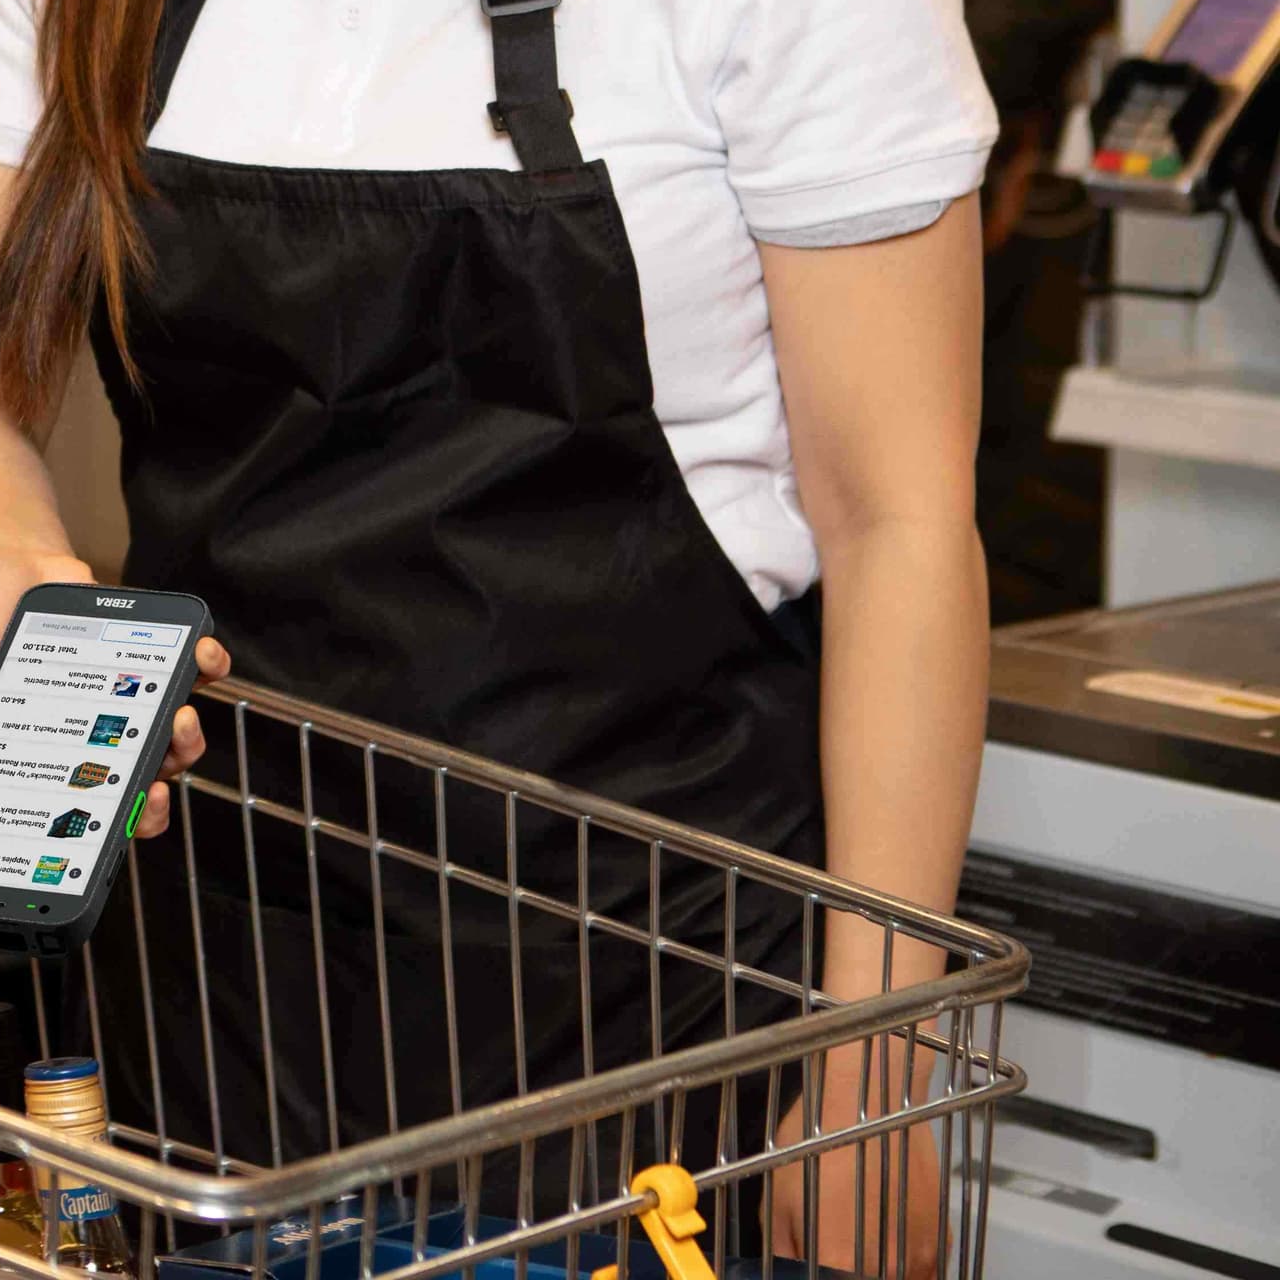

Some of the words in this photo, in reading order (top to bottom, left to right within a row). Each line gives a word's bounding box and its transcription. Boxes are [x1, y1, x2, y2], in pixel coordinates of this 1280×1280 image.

[96, 596, 136, 609] ZEBRA
[130, 631, 153, 639] Cancel
[22, 642, 56, 653] $211.00
[57, 646, 78, 655] Total
[116, 651, 122, 659] 6
[124, 652, 152, 662] Items:
[153, 655, 167, 663] No.
[68, 671, 108, 682] Toothbrush
[23, 677, 51, 686] Electric
[51, 679, 68, 688] Kids
[67, 681, 81, 689] Pro
[0, 696, 26, 705] $64.00
[58, 727, 85, 737] Gillette
[20, 761, 37, 769] Dark
[37, 762, 70, 773] Espresso
[16, 769, 26, 779] by
[0, 807, 18, 816] Dark
[17, 808, 51, 819] Espresso
[60, 1189, 112, 1219] Captain
